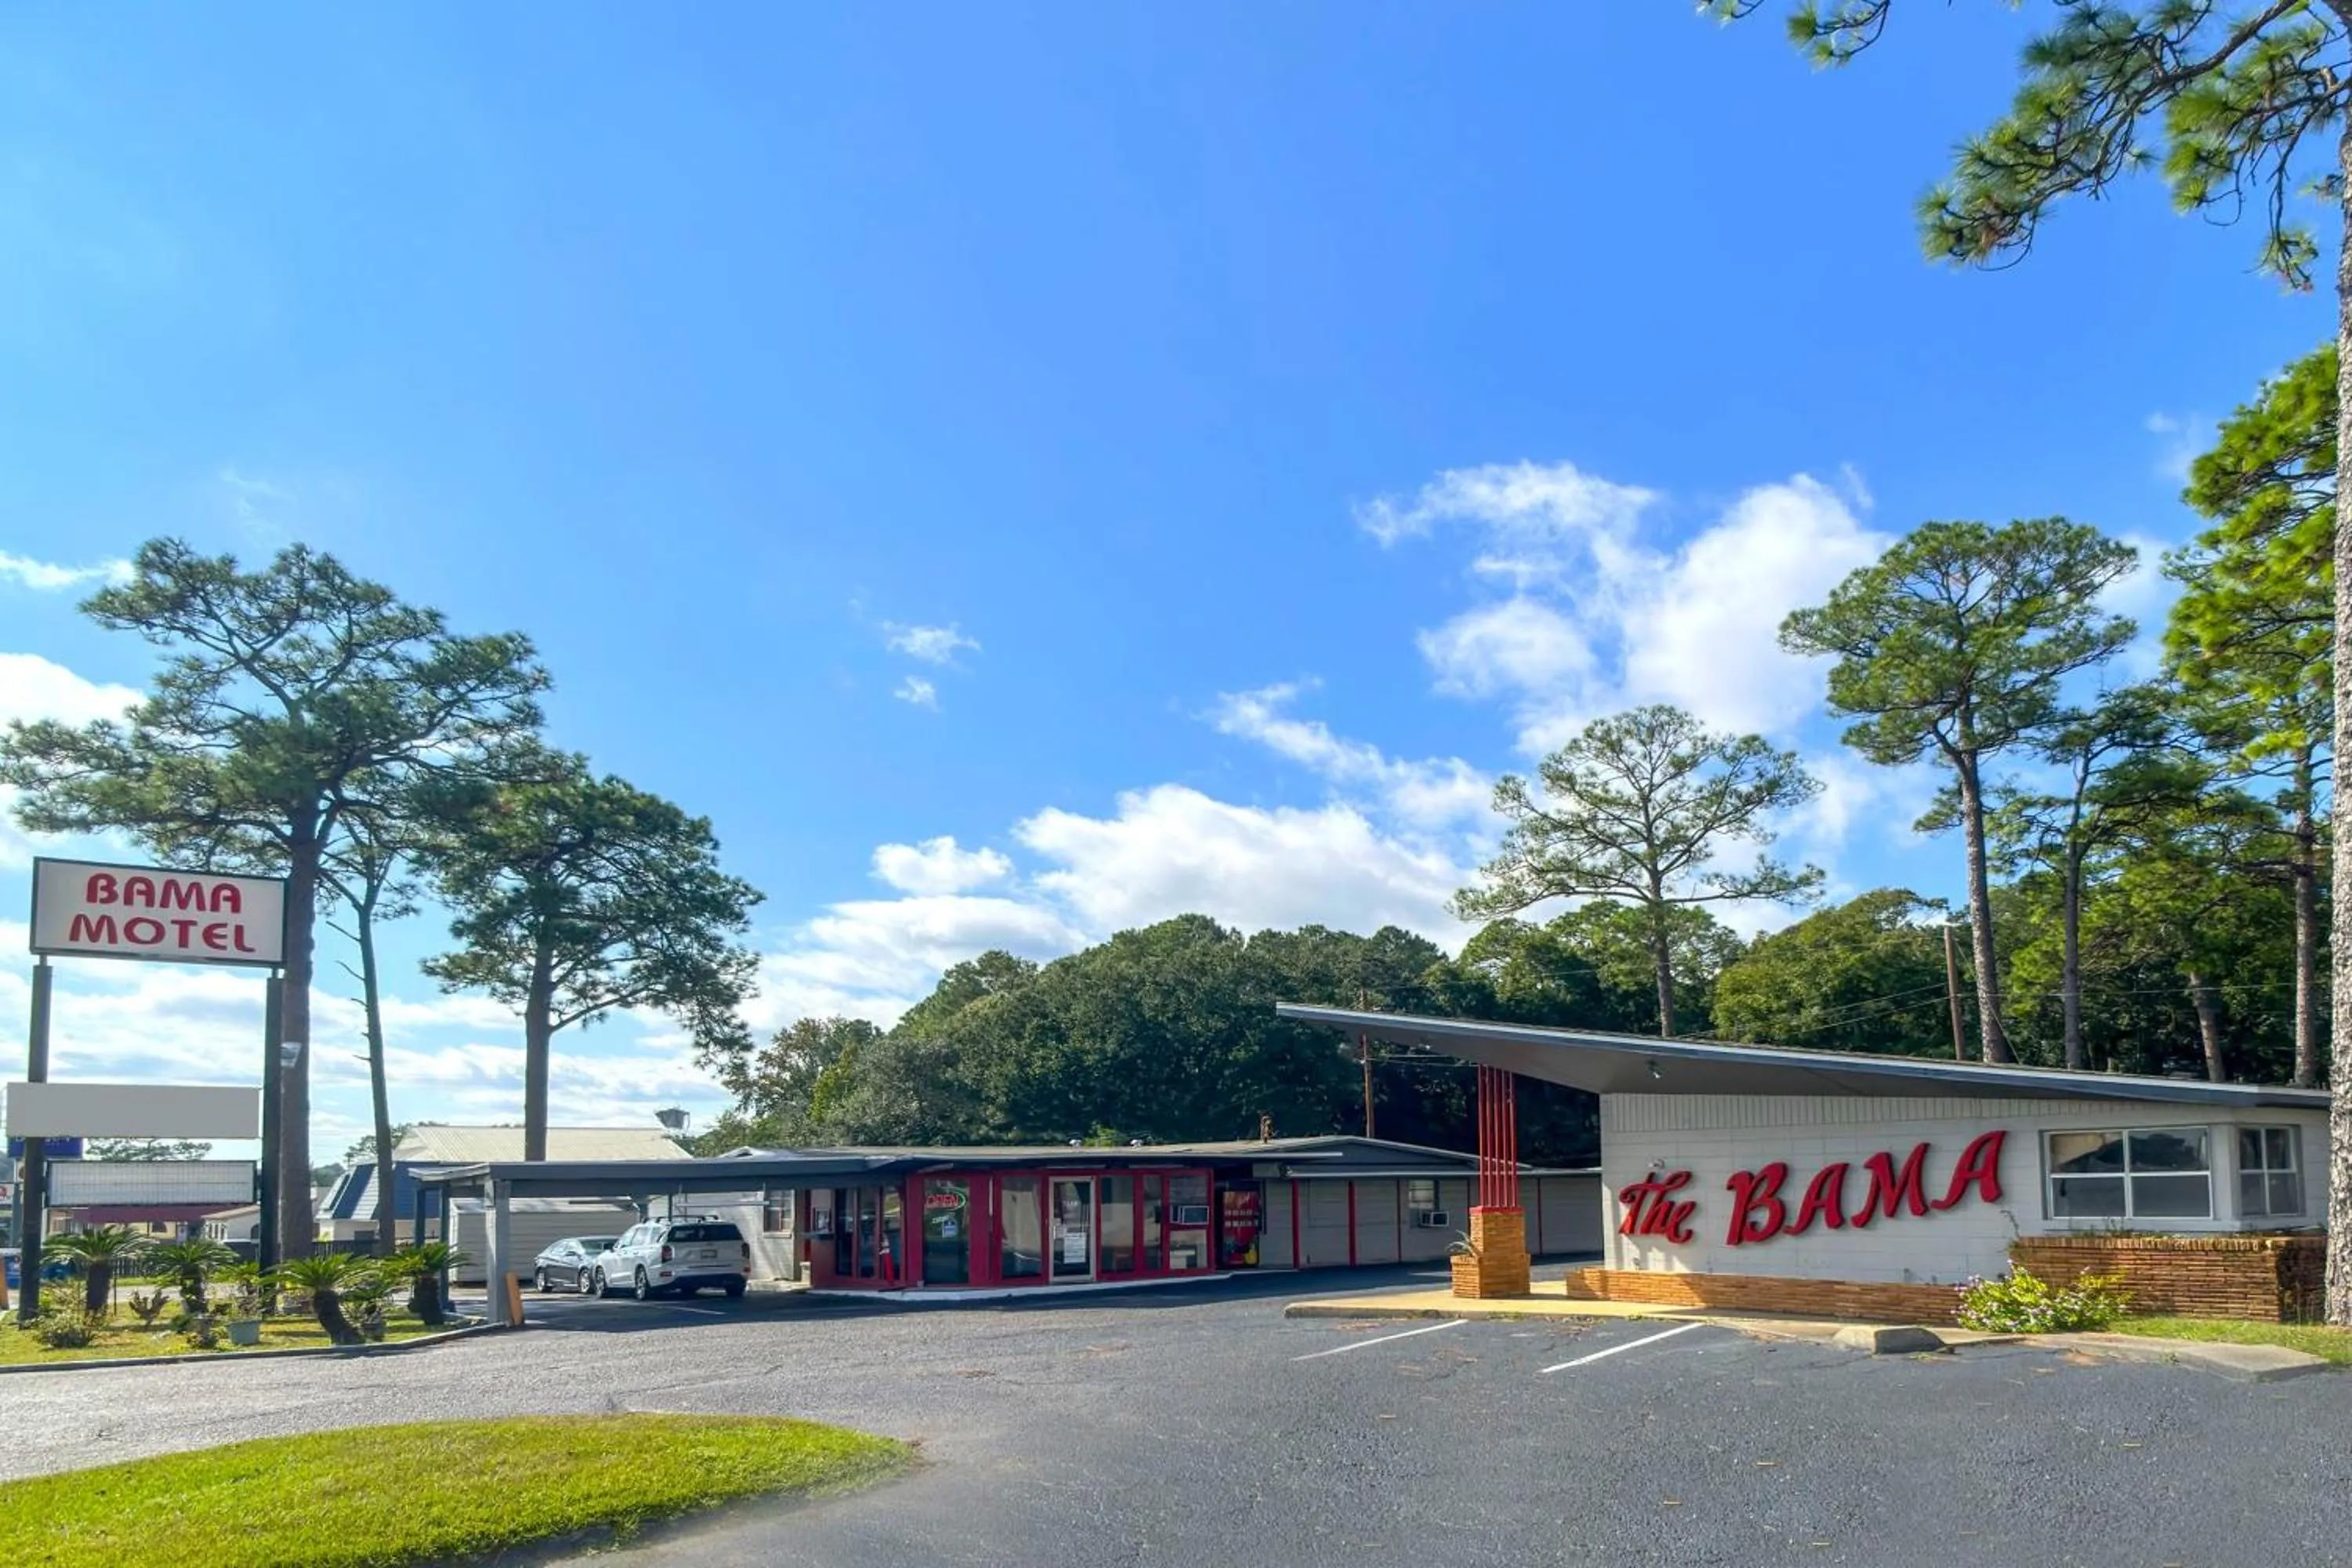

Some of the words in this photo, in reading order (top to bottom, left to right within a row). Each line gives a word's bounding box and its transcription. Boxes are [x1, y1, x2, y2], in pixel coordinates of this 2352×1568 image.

[86, 873, 241, 913] BAMA
[69, 914, 256, 952] MOTEL
[1618, 1171, 1697, 1244] The
[1726, 1130, 2007, 1246] BAMA
